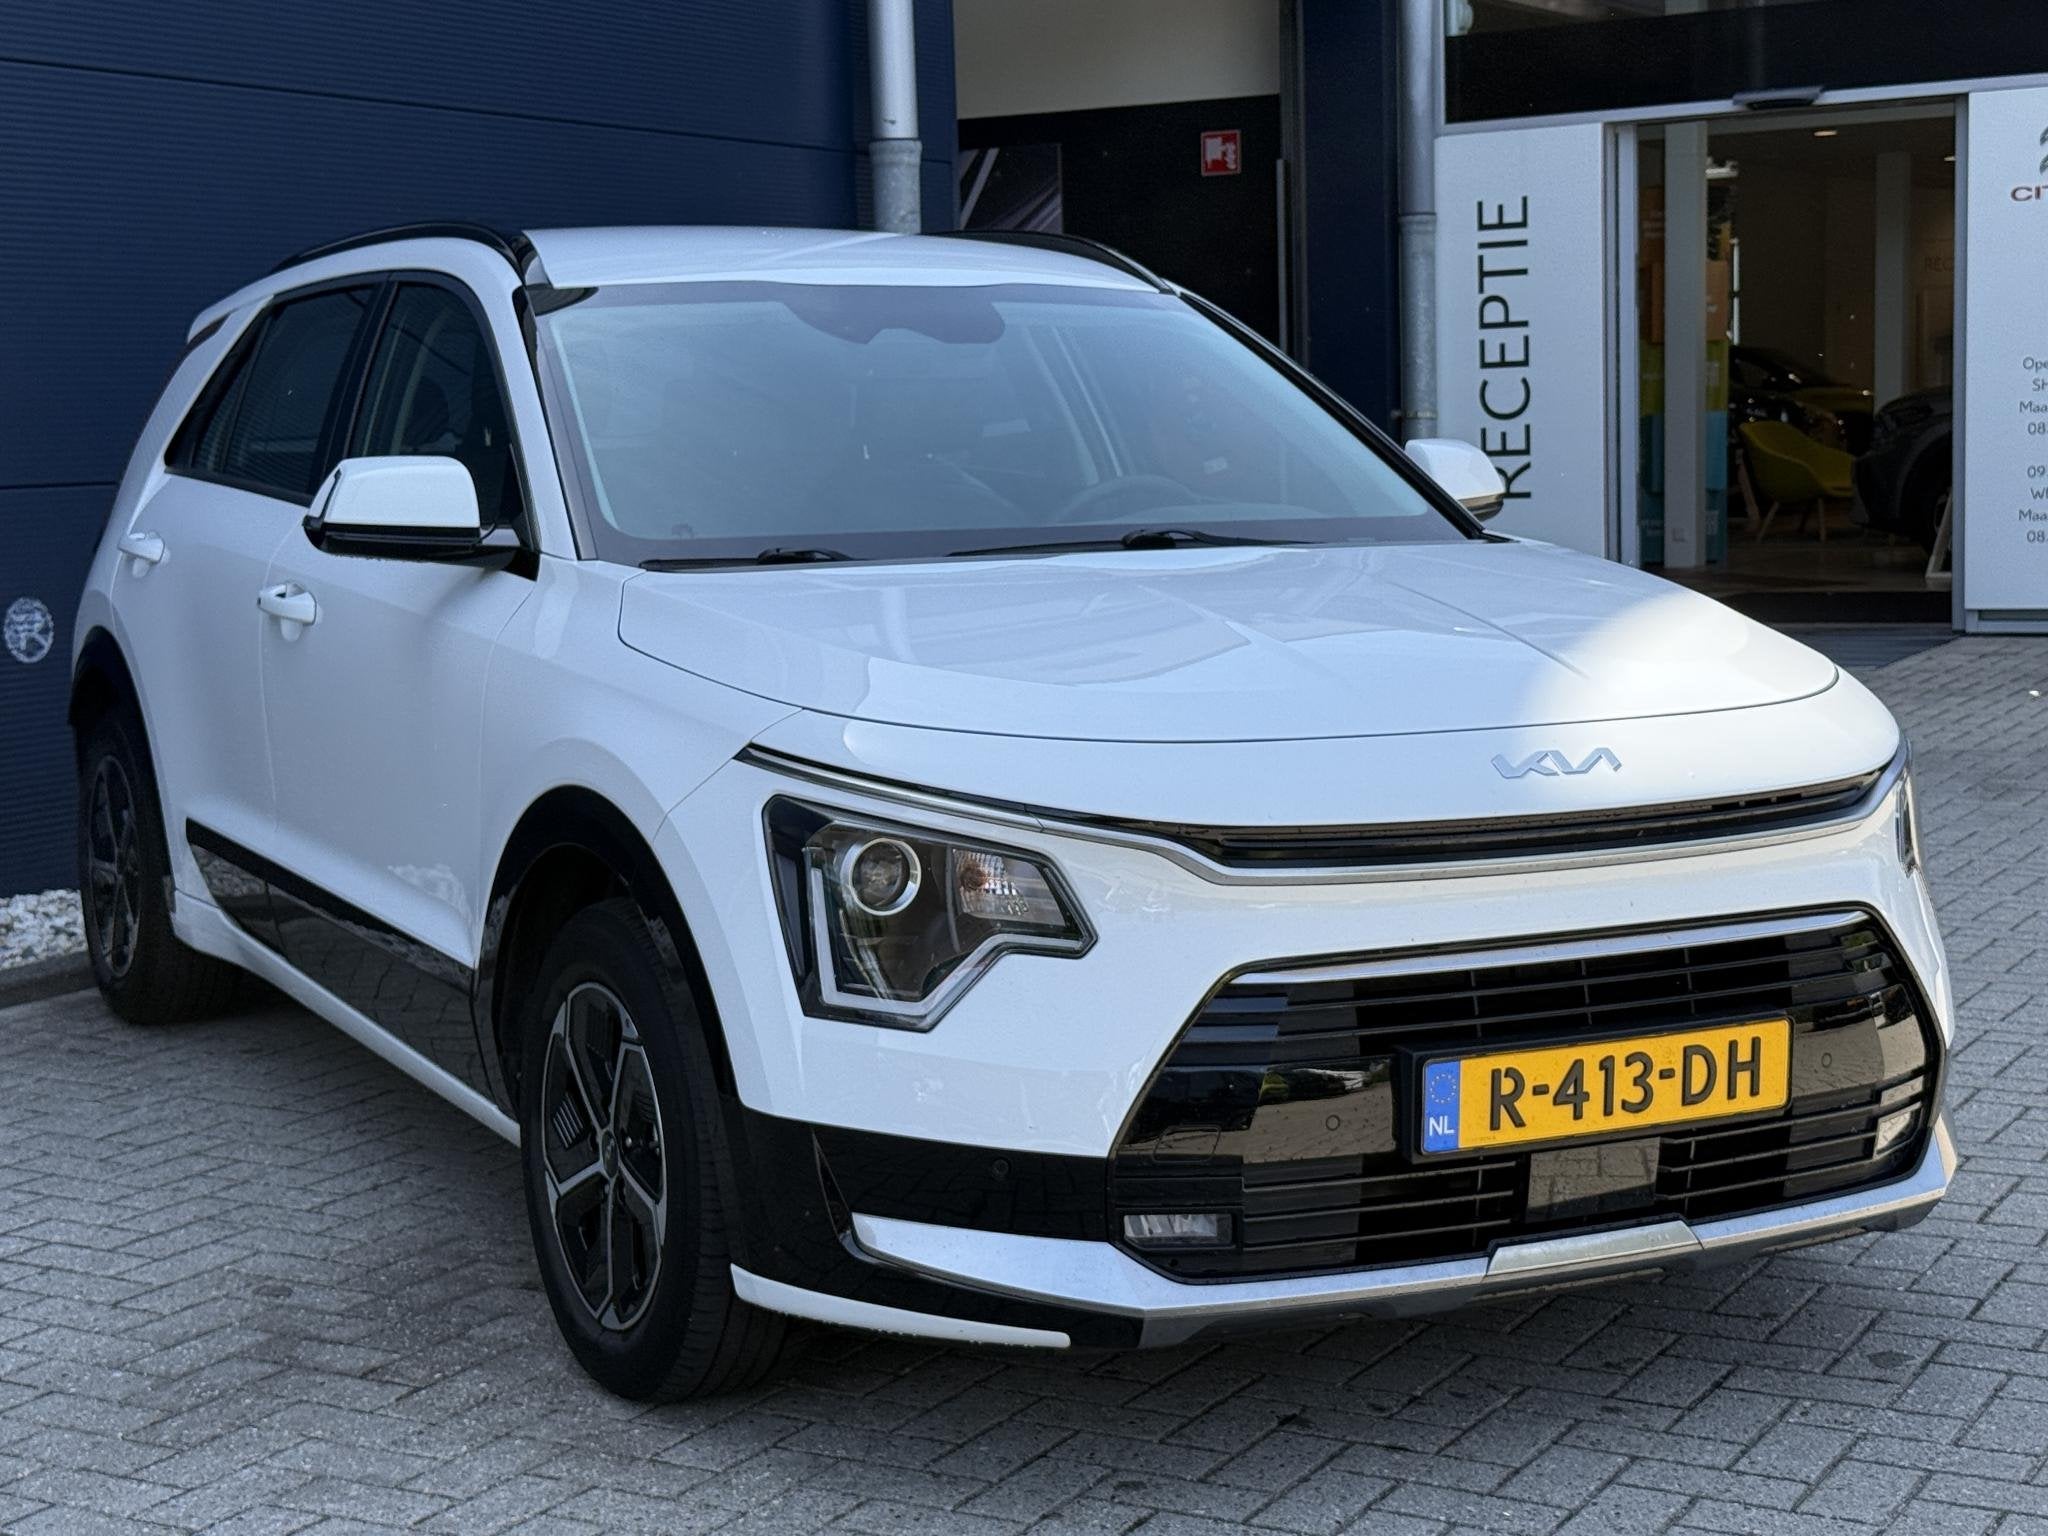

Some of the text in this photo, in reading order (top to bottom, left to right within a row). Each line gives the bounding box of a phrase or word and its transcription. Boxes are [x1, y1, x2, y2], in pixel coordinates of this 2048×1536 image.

[1477, 195, 1532, 499] RECEPTIE
[1428, 1115, 1455, 1136] NL
[1489, 1036, 1762, 1131] R-413-DH
